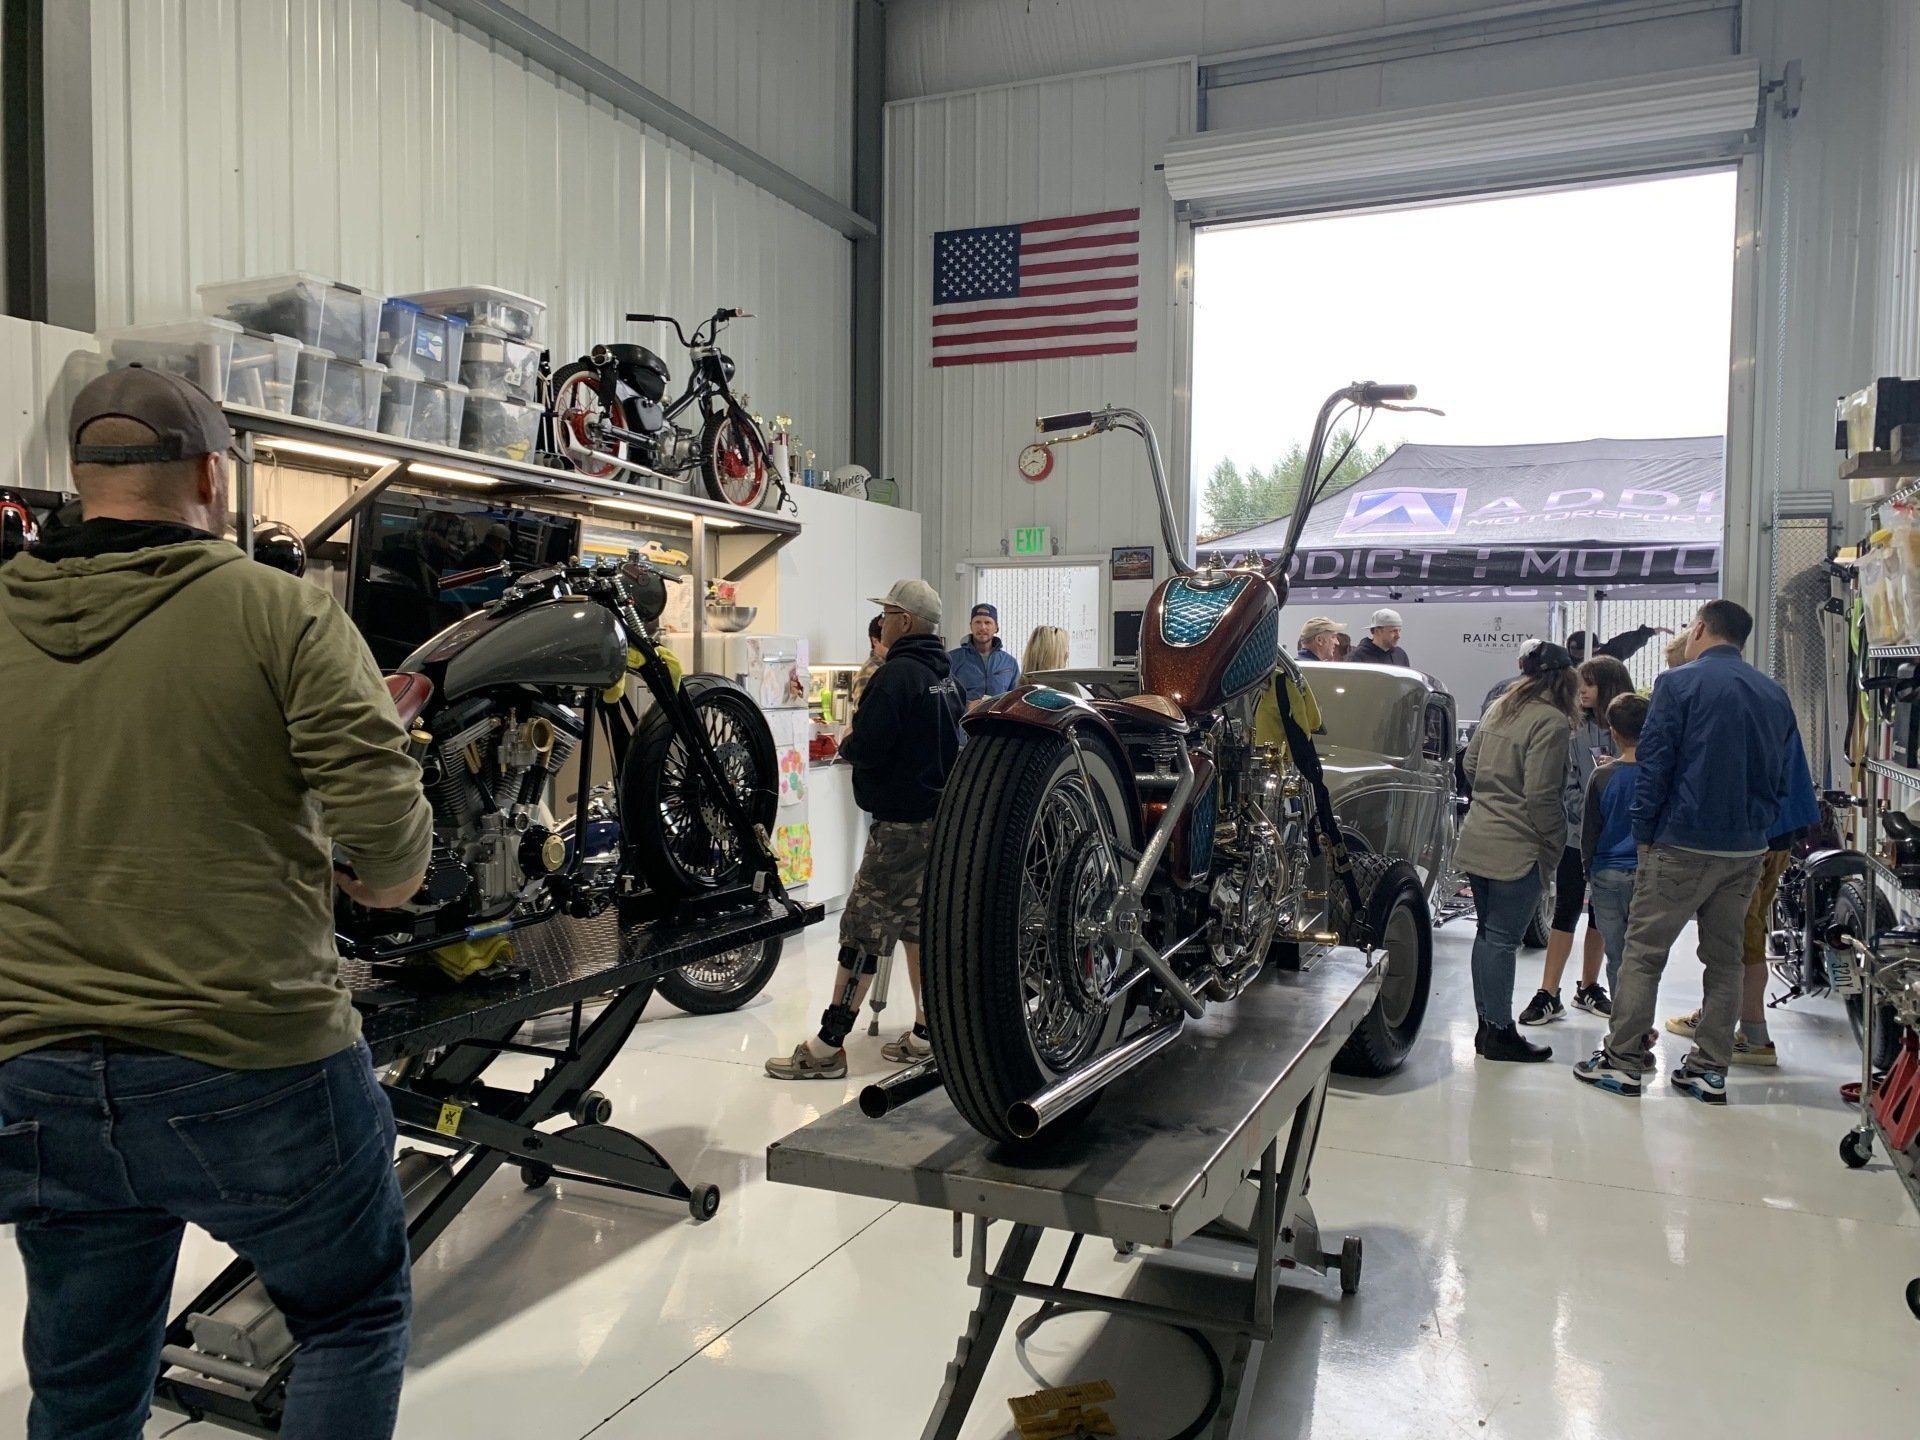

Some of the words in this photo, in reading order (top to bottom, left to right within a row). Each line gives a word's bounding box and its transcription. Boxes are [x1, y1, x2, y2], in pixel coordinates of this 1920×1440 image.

[1467, 488, 1715, 517] ADDI
[1467, 509, 1721, 526] MOTORSPORT
[1016, 527, 1045, 553] EXIT
[1520, 547, 1720, 577] MOTO
[1463, 633, 1497, 643] RAIN
[1501, 633, 1534, 642] CITY
